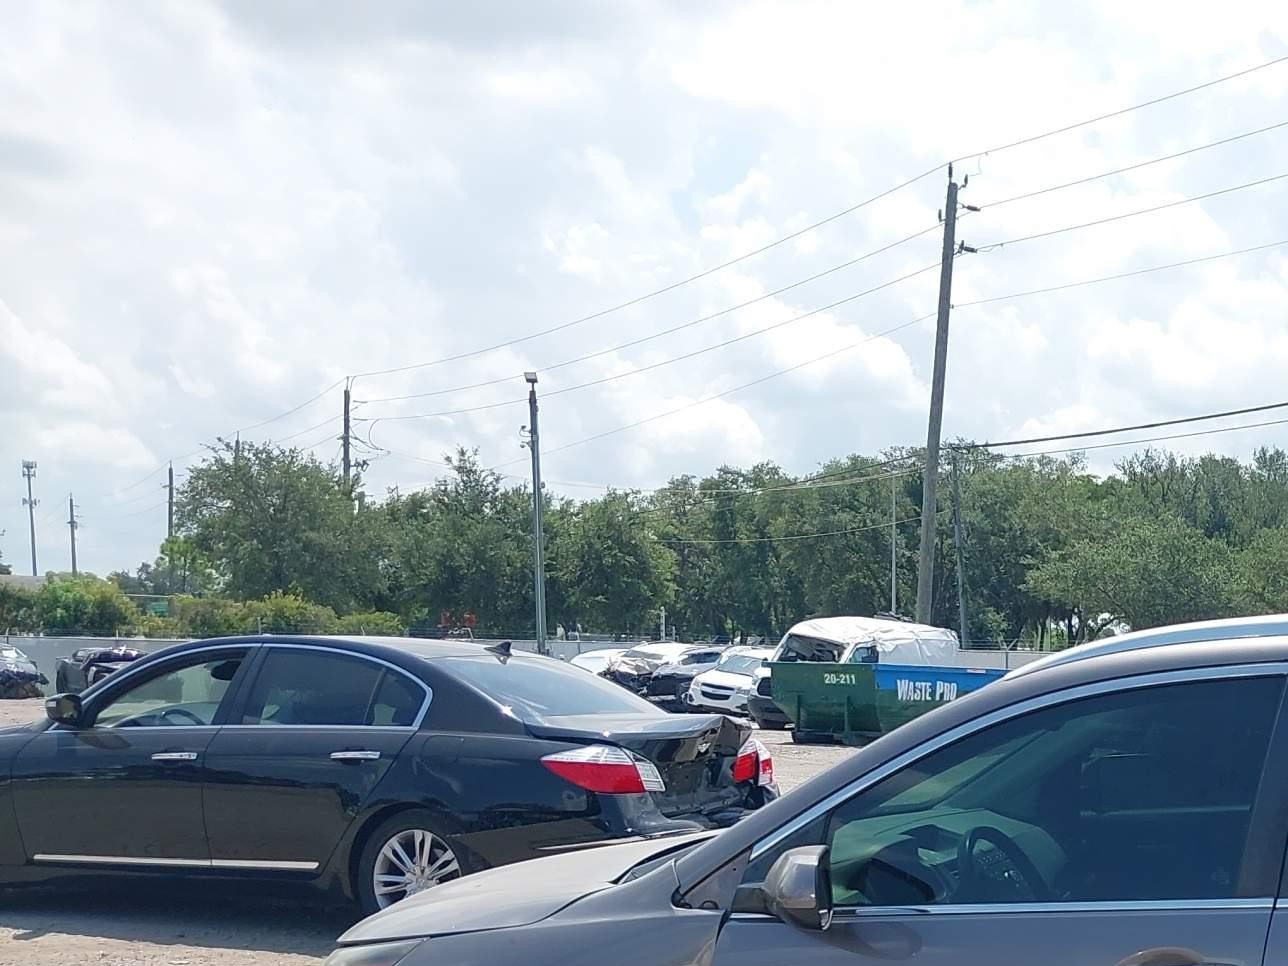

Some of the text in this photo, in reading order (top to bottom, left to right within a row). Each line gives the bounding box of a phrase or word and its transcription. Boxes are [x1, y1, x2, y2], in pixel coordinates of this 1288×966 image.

[824, 673, 856, 684] 20-211
[897, 679, 957, 701] WASTE PRO
